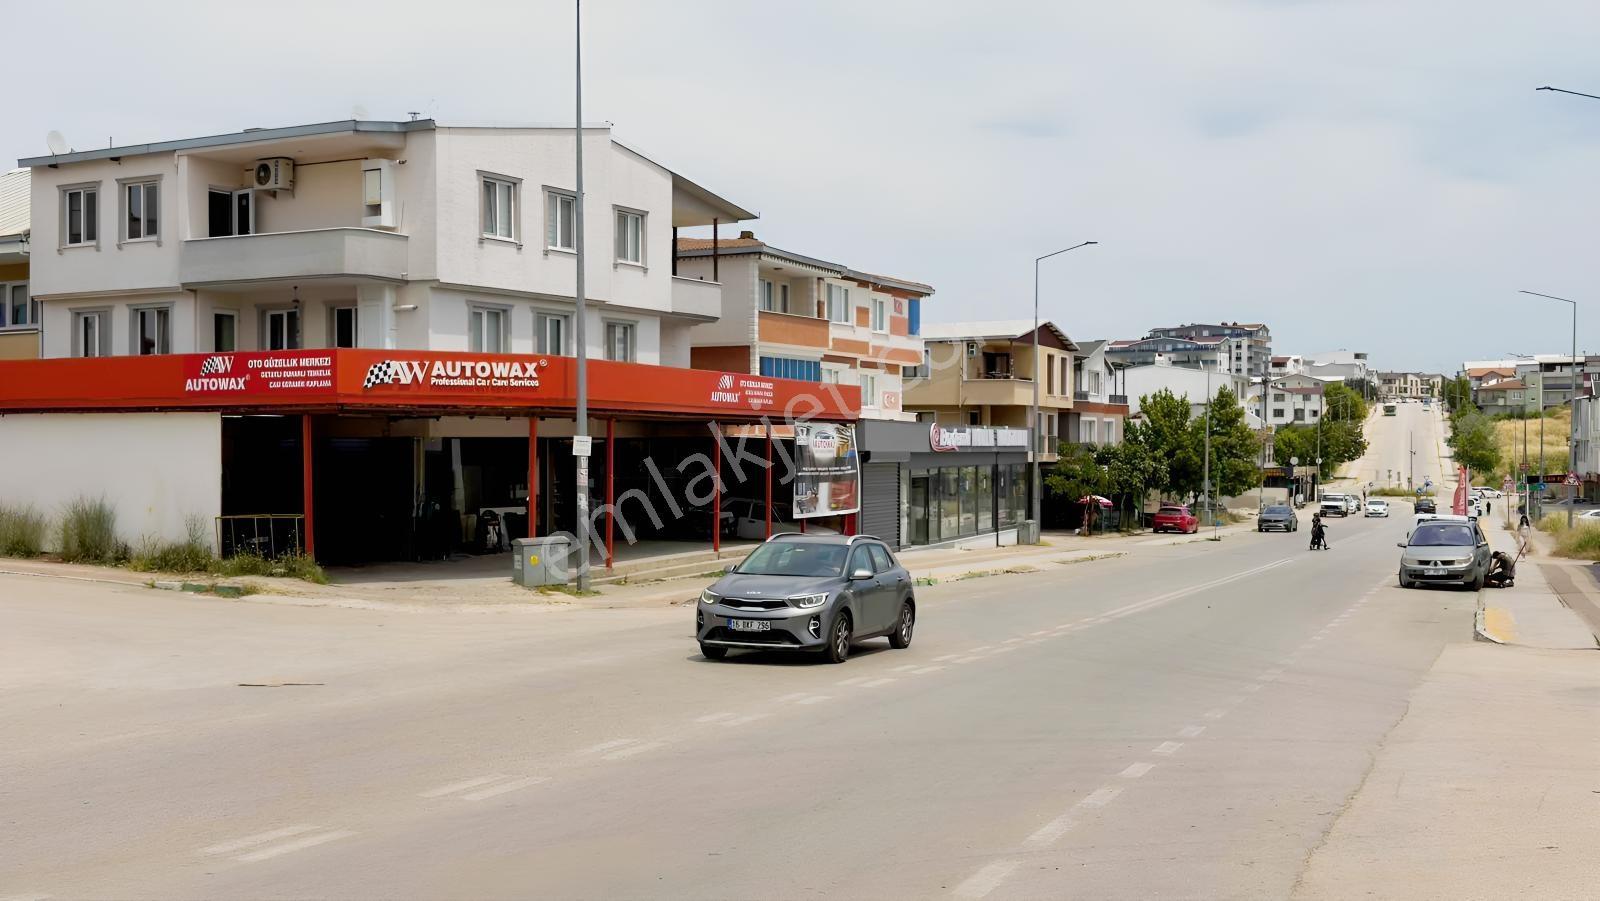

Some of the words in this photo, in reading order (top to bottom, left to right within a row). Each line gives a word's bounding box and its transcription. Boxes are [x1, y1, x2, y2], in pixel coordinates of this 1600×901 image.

[248, 359, 262, 368] OTO
[185, 378, 245, 391] AUTOWAX
[430, 378, 475, 386] Professional
